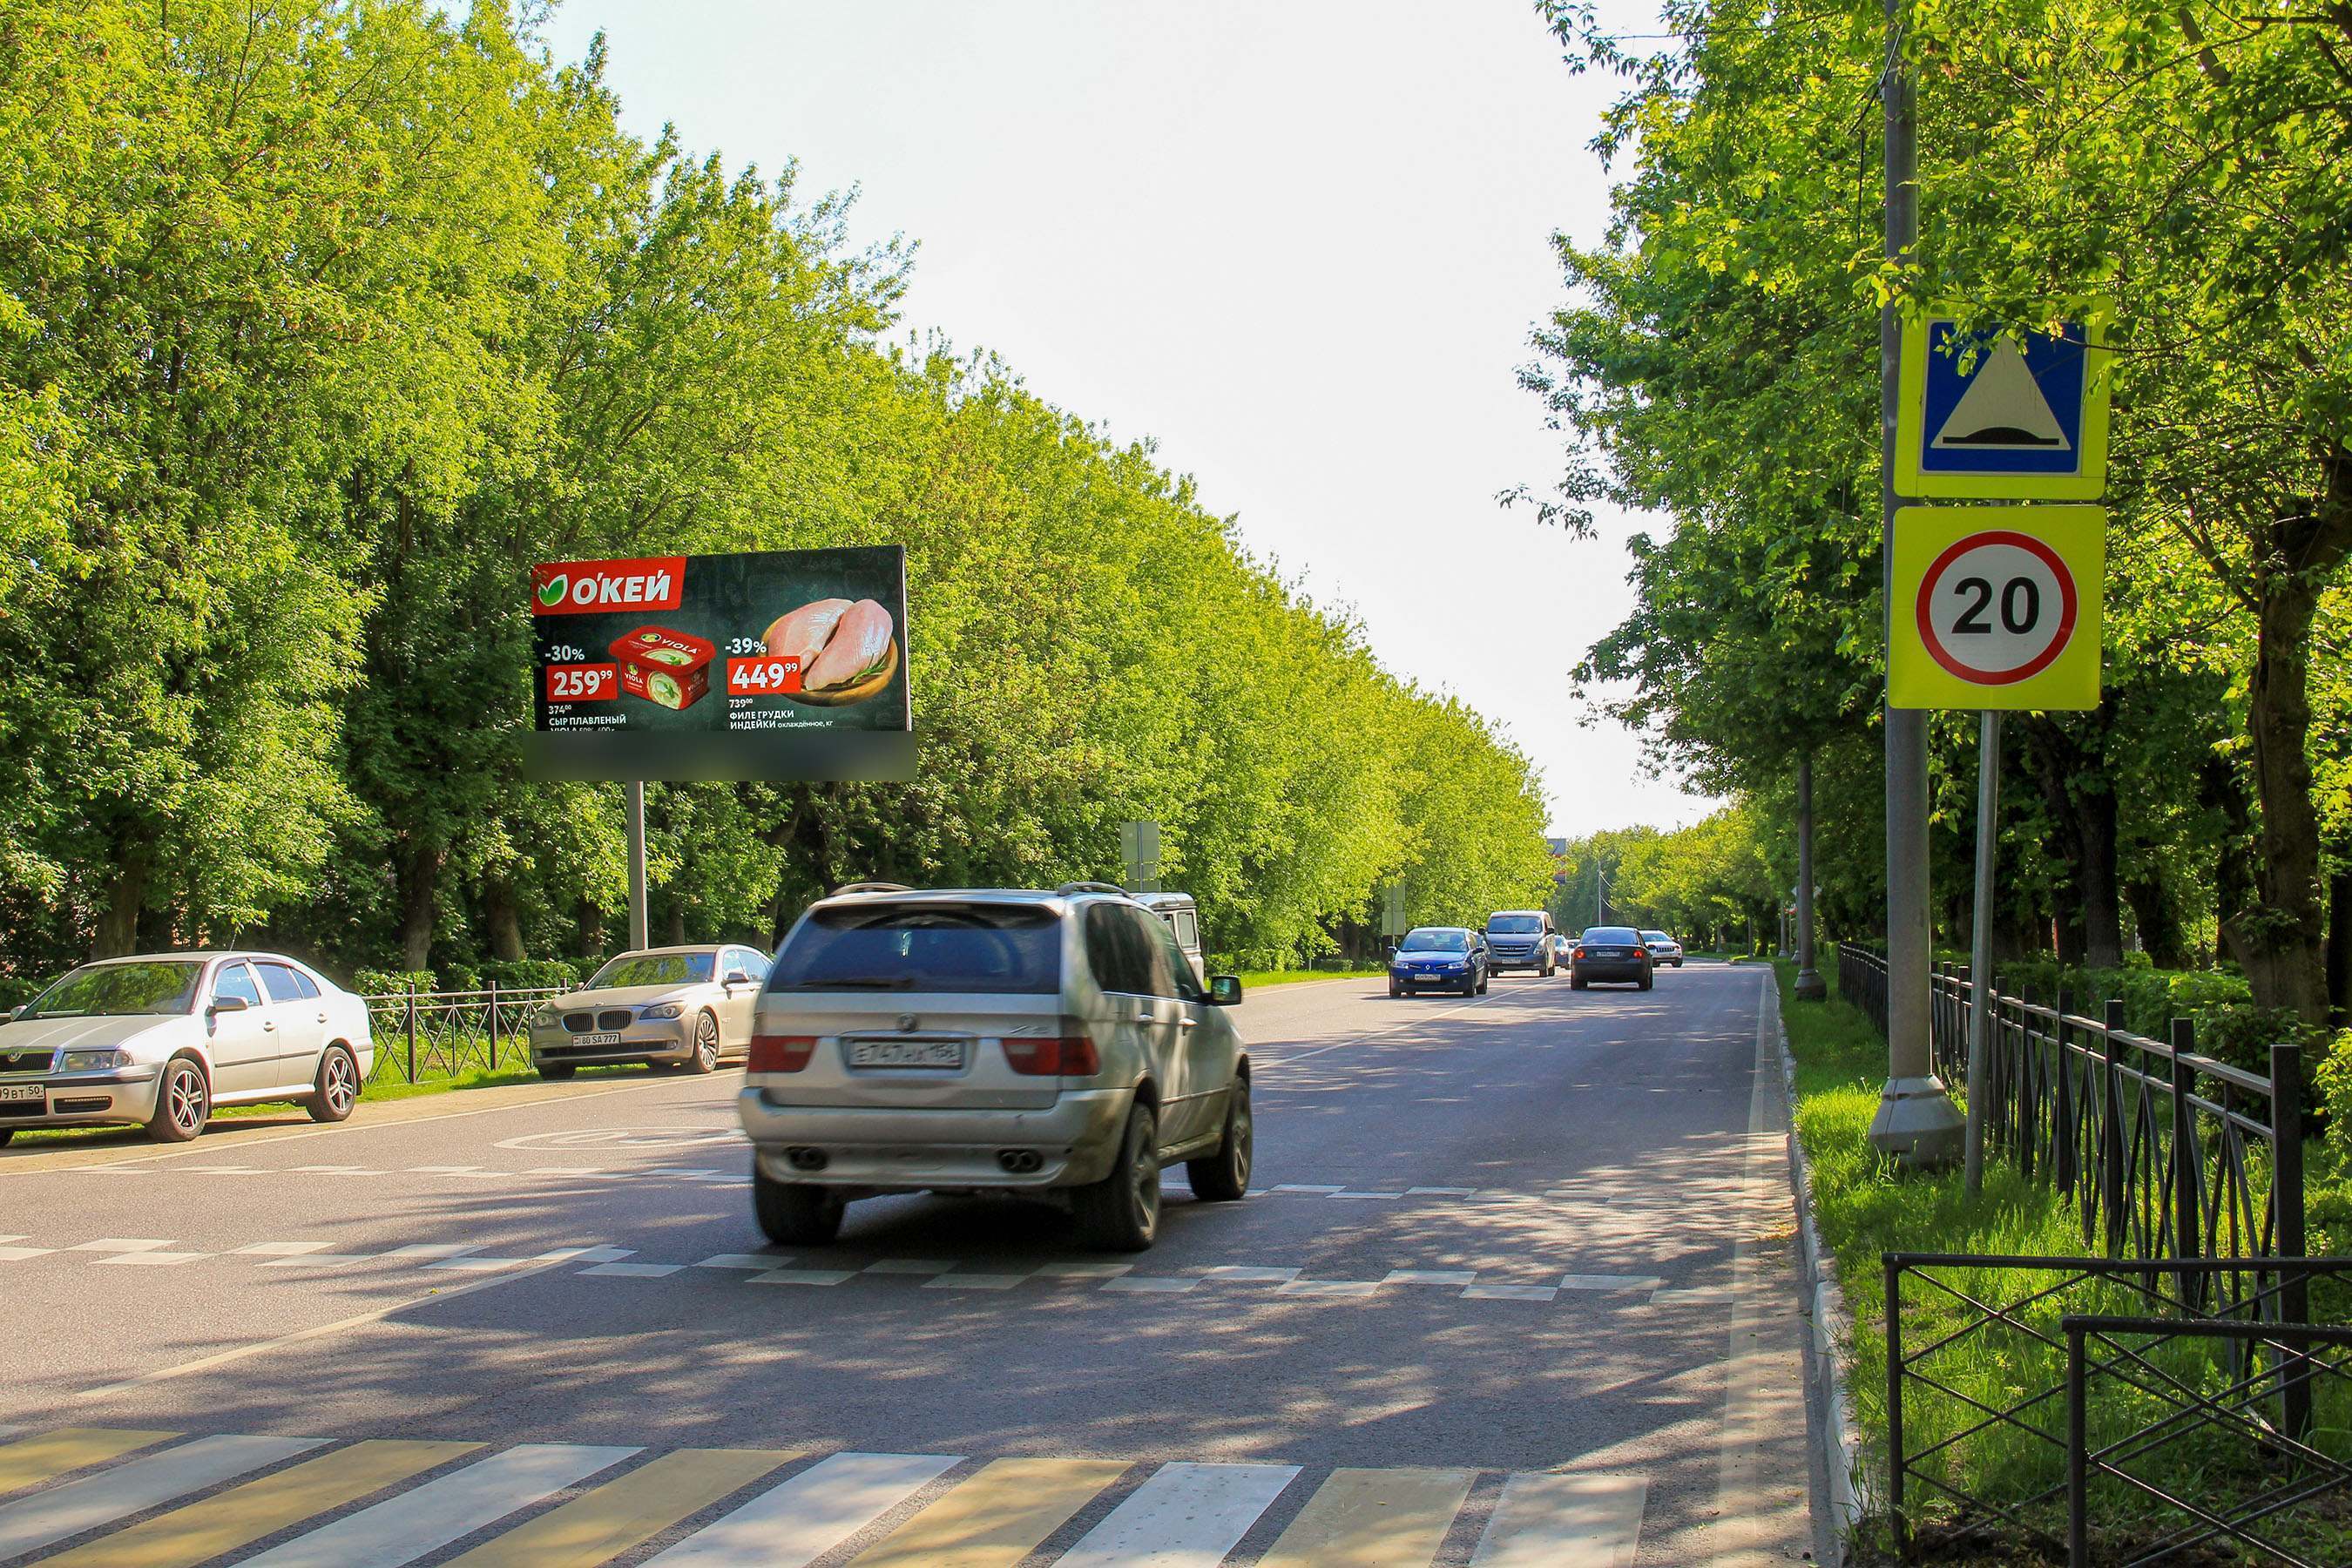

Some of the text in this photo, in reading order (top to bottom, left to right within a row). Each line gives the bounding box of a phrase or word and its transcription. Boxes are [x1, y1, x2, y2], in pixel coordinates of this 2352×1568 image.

[1950, 577, 2039, 635] 20
[661, 639, 698, 654] VIOLA
[725, 637, 767, 654] -39%
[544, 645, 585, 661] -30%
[569, 713, 626, 726] ПЛАВЛЕНЫЙ
[729, 710, 794, 720] ФИЛЕ ГРУДКИ
[730, 719, 776, 730] ИНДЕЙКИ
[604, 1034, 618, 1043] 777
[28, 1085, 40, 1095] 50
